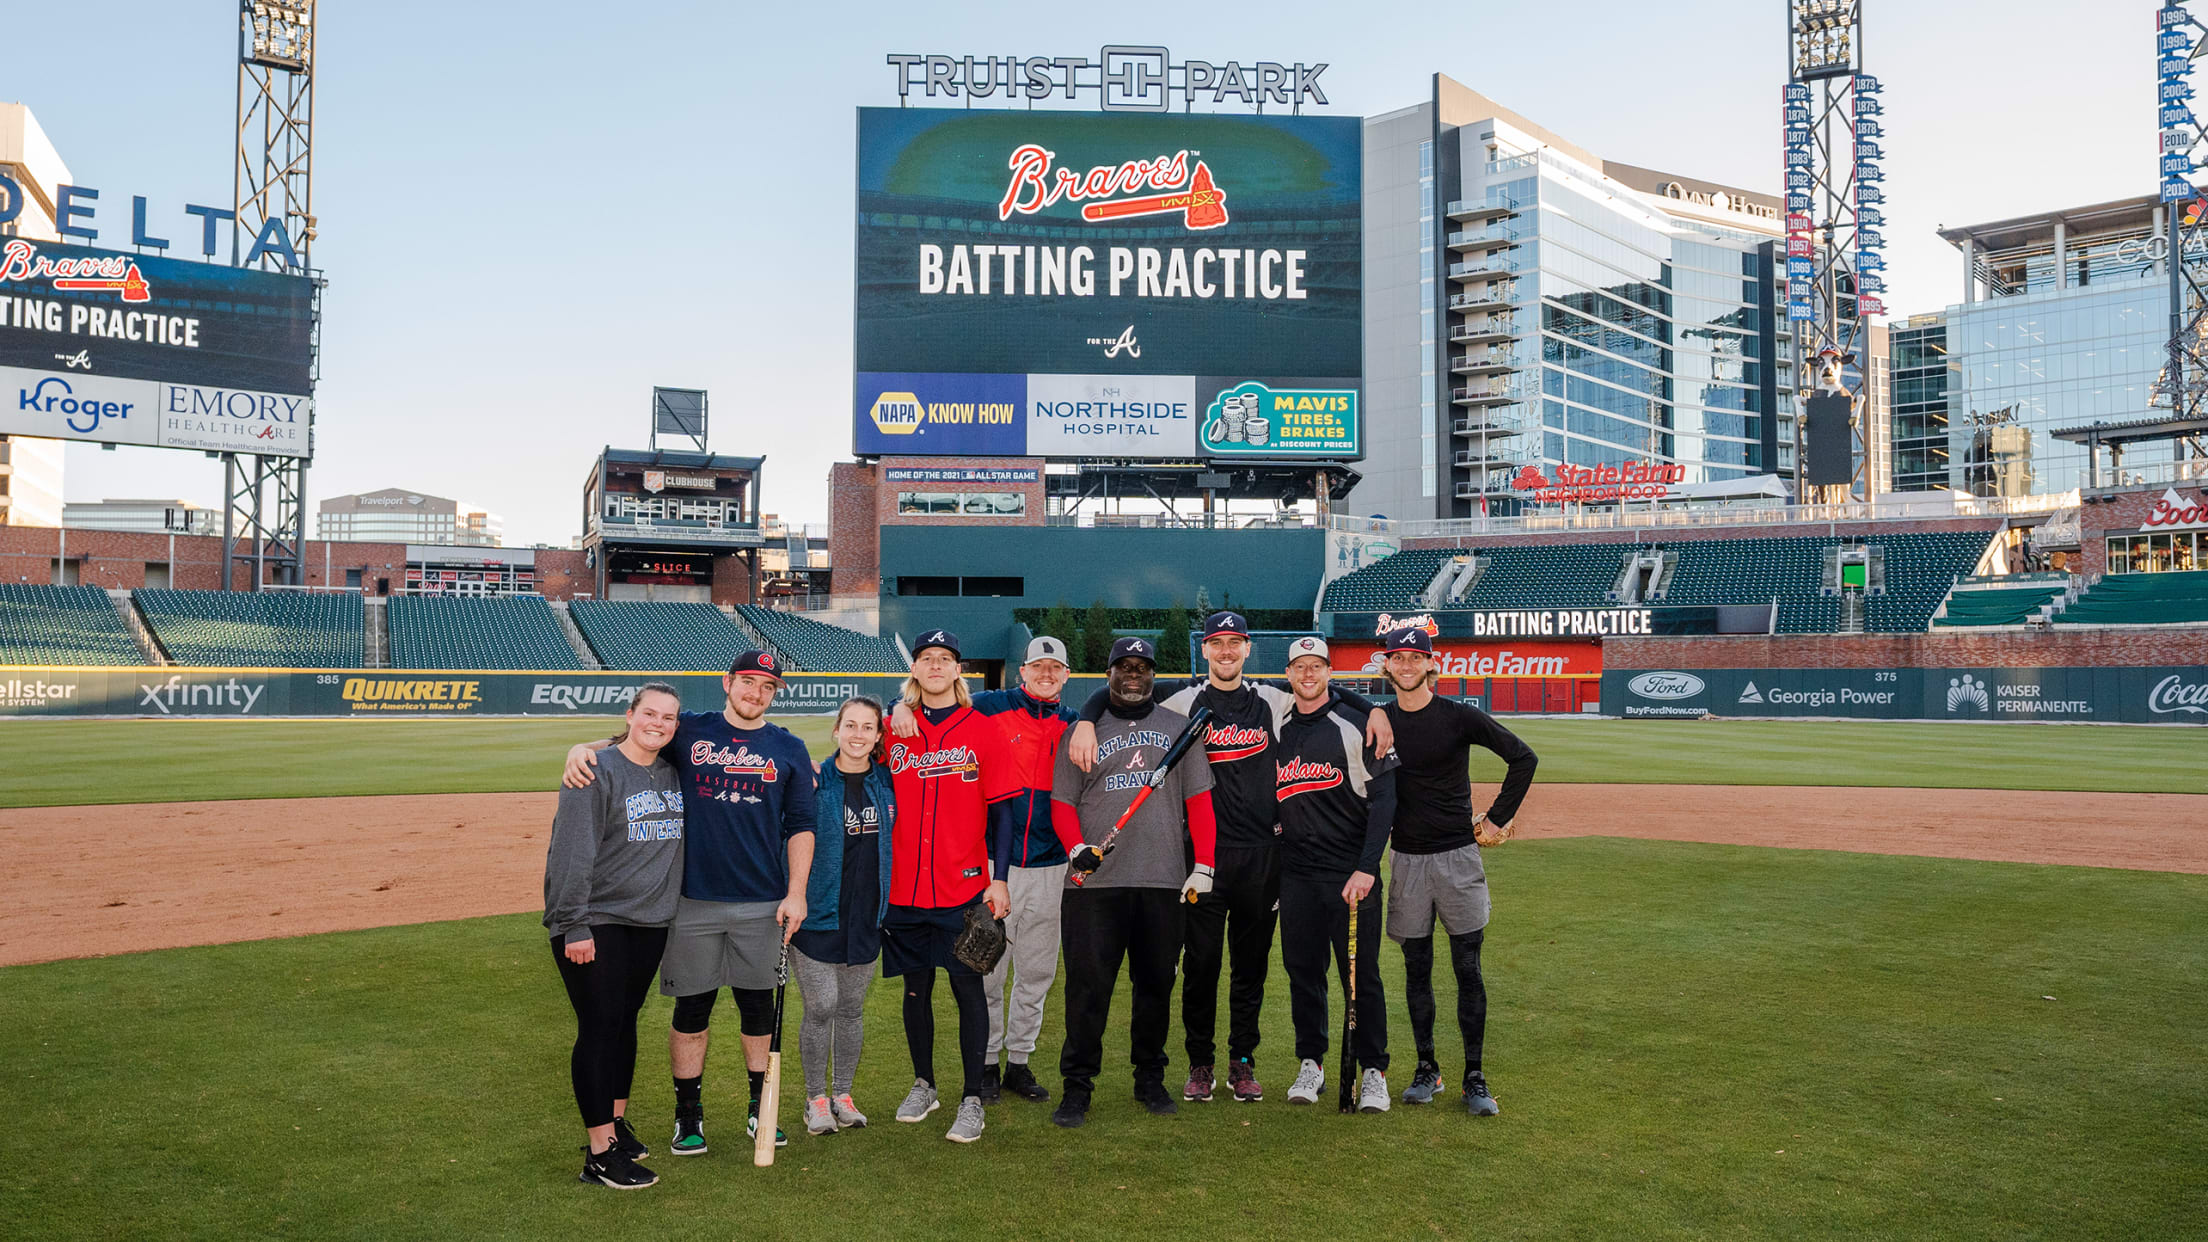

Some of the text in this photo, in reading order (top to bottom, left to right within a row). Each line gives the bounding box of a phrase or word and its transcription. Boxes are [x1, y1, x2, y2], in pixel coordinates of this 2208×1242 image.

[2162, 9, 2186, 25] 1996
[2162, 34, 2186, 50] 1998
[2163, 59, 2188, 74] 2000
[887, 54, 1329, 105] TRUIST PARK
[1856, 79, 1875, 90] 1873
[1787, 88, 1806, 99] 1872
[2163, 83, 2188, 98] 2002
[2163, 108, 2188, 123] 2004
[1788, 132, 1806, 142] 1877
[2165, 133, 2187, 147] 2010
[1857, 145, 1877, 156] 1891
[2165, 158, 2188, 172] 2013
[1858, 167, 1878, 178] 1893
[998, 145, 1190, 221] Braves
[1789, 175, 1808, 186] 1892
[1858, 188, 1878, 200] 1898
[2166, 183, 2189, 197] 2019
[1789, 197, 1808, 208] 1897
[1859, 211, 1879, 222] 1948
[1790, 219, 1808, 229] 1914
[0, 240, 126, 282] Braves
[920, 244, 1307, 299] BATTING PRACTICE
[1791, 284, 1809, 295] 1991
[1860, 278, 1880, 289] 1992
[1791, 306, 1810, 317] 1993
[1860, 300, 1881, 311] 1995
[71, 304, 199, 348] PRACTICE
[19, 377, 134, 433] Kroger
[168, 386, 303, 423] EMORY
[1036, 401, 1188, 419] NORTHSIDE
[1274, 396, 1349, 411] MAVIS
[879, 403, 1014, 424] NAPA KNOW HOW
[1283, 413, 1334, 425] TIRES
[168, 418, 296, 440] HEALTHCARE
[1064, 423, 1160, 435] HOSPITAL
[1280, 427, 1345, 438] BRAKES
[168, 437, 300, 455] Official Team Healthcare Provider
[1324, 441, 1353, 449] PRICES
[665, 476, 714, 488] CLUBHOUSE
[888, 471, 912, 479] HOME
[913, 471, 924, 479] OF
[924, 471, 940, 479] THE
[942, 471, 960, 479] 2021
[1013, 471, 1036, 480] GAME
[360, 496, 403, 506] Travelport
[654, 563, 692, 572] SLICE
[1474, 611, 1553, 636] BATTING
[1558, 610, 1652, 635] PRACTICE
[316, 674, 339, 685] 385
[1875, 672, 1897, 682] 375
[342, 678, 480, 702] QUIKRETE
[1644, 676, 1688, 695] Ford
[1997, 684, 2040, 697] KAISER
[140, 675, 264, 714] xfinity
[531, 684, 642, 710] EQUIFA
[1769, 688, 1895, 707] Georgia Power
[8, 698, 45, 706] SYSTEM
[352, 702, 375, 710] What
[380, 702, 427, 711] America's
[429, 702, 455, 711] Made
[771, 700, 837, 708] BuyHyundai.com
[1997, 701, 2087, 713] PERMANENTE
[1626, 706, 1708, 715] BuyFordNow.com
[691, 740, 765, 765] October
[1097, 731, 1172, 764] ATLANTA
[889, 743, 967, 774] Braves
[1276, 755, 1336, 786] utlaws
[1106, 771, 1165, 792] BRAV
